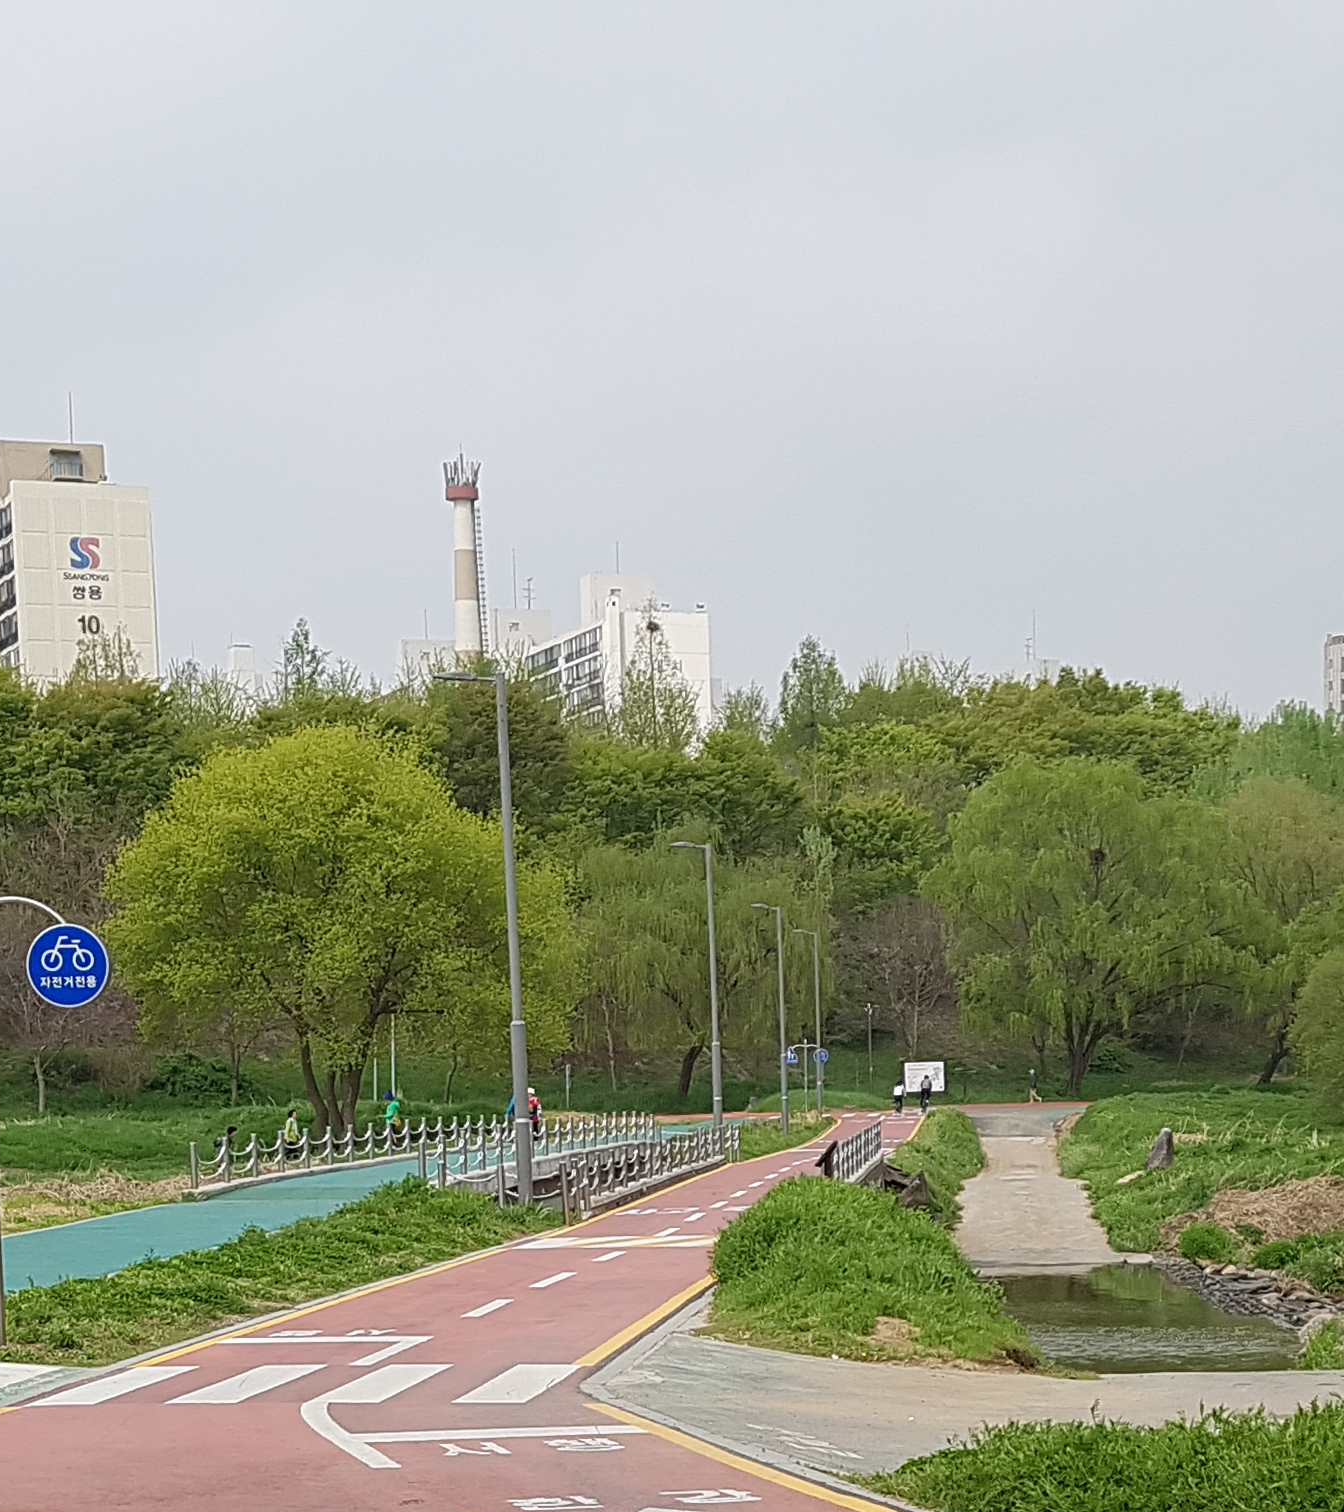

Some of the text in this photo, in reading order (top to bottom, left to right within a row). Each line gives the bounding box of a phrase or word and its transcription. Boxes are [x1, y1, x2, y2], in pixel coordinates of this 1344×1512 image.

[72, 585, 103, 600] 쌍용
[77, 614, 101, 635] 10
[40, 974, 97, 989] 자전거전용
